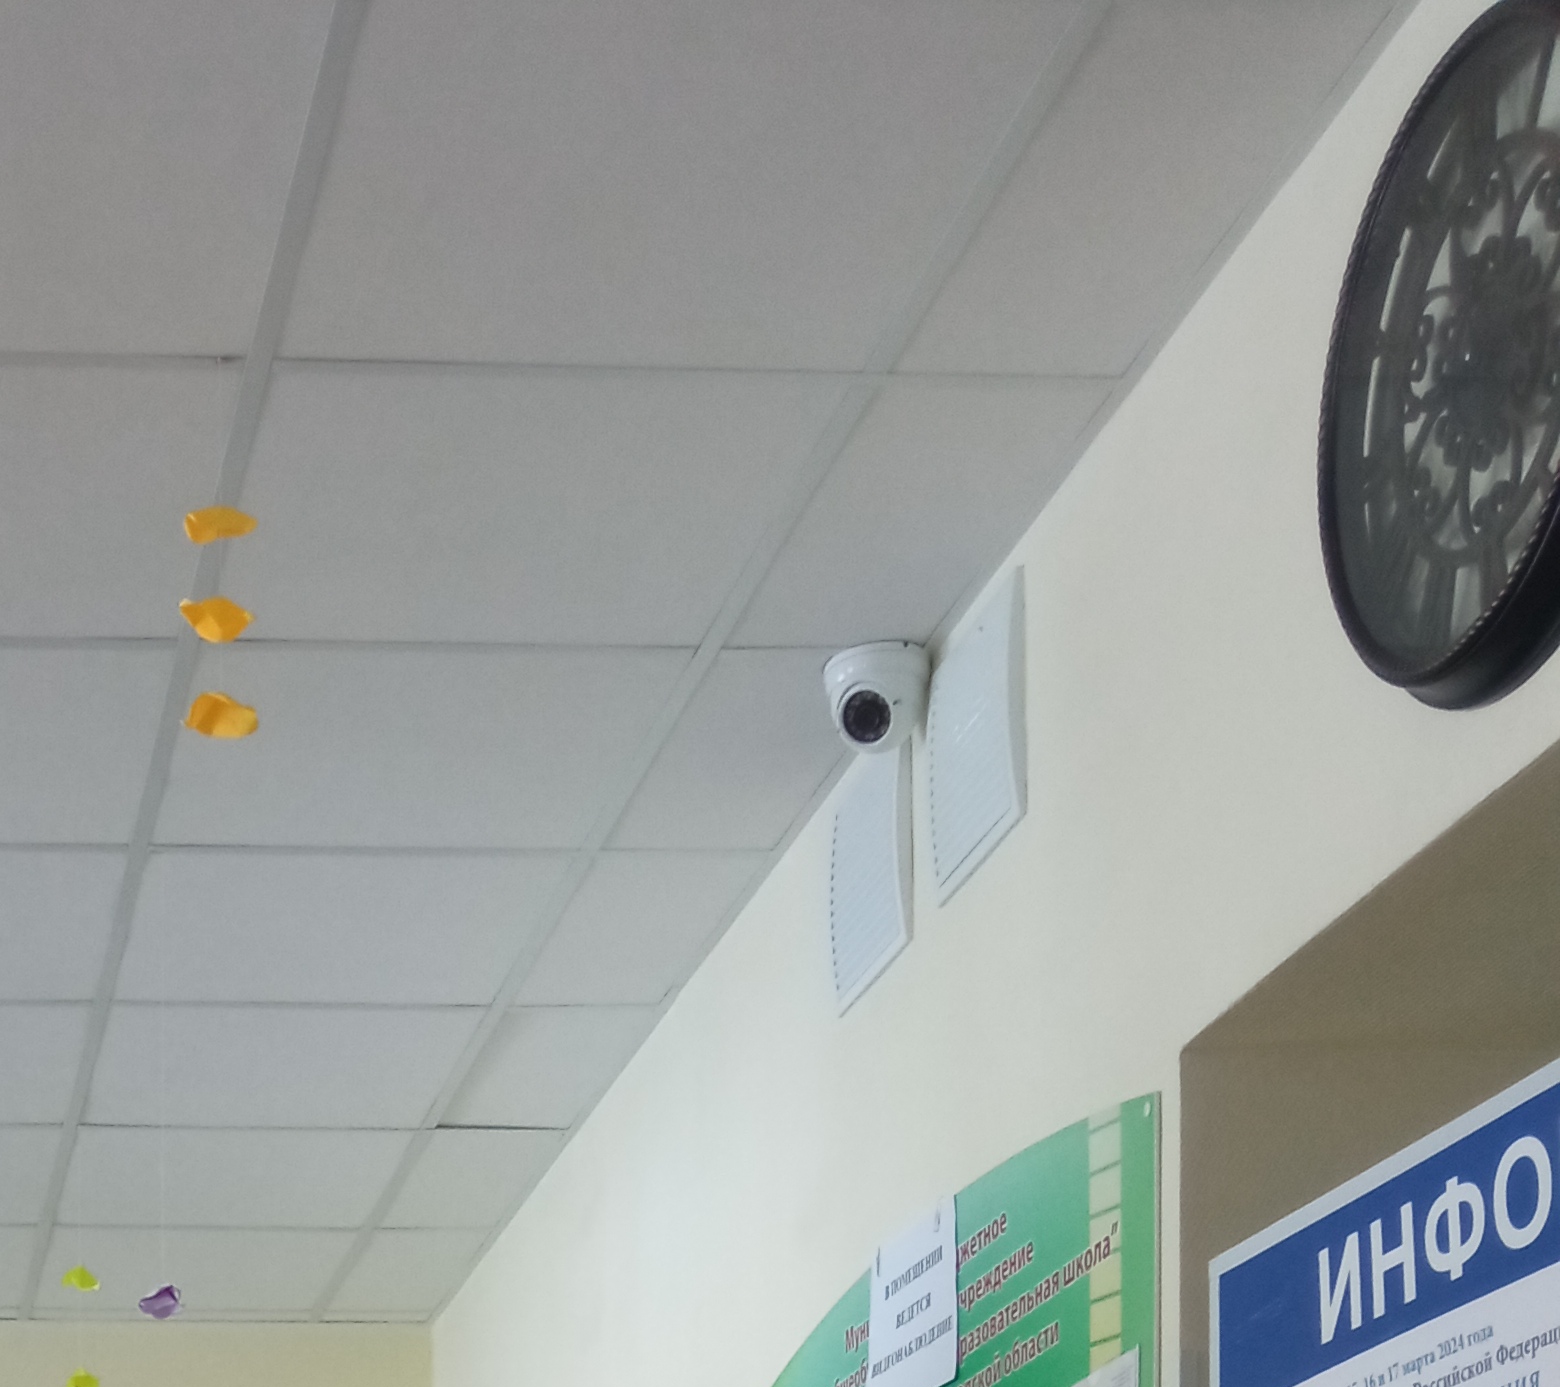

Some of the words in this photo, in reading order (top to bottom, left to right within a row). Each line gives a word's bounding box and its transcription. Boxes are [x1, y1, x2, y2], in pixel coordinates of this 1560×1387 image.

[957, 1212, 1007, 1272] жетное
[1317, 1135, 1553, 1345] ИНФО
[957, 1241, 1034, 1311] чреждение
[957, 1270, 1060, 1363] разовательная
[1496, 1326, 1560, 1366] Федерац
[1004, 1321, 1059, 1376] области
[1388, 1363, 1399, 1382] 17
[1402, 1353, 1435, 1376] марта
[1437, 1334, 1465, 1360] 2024
[1467, 1325, 1494, 1346] года
